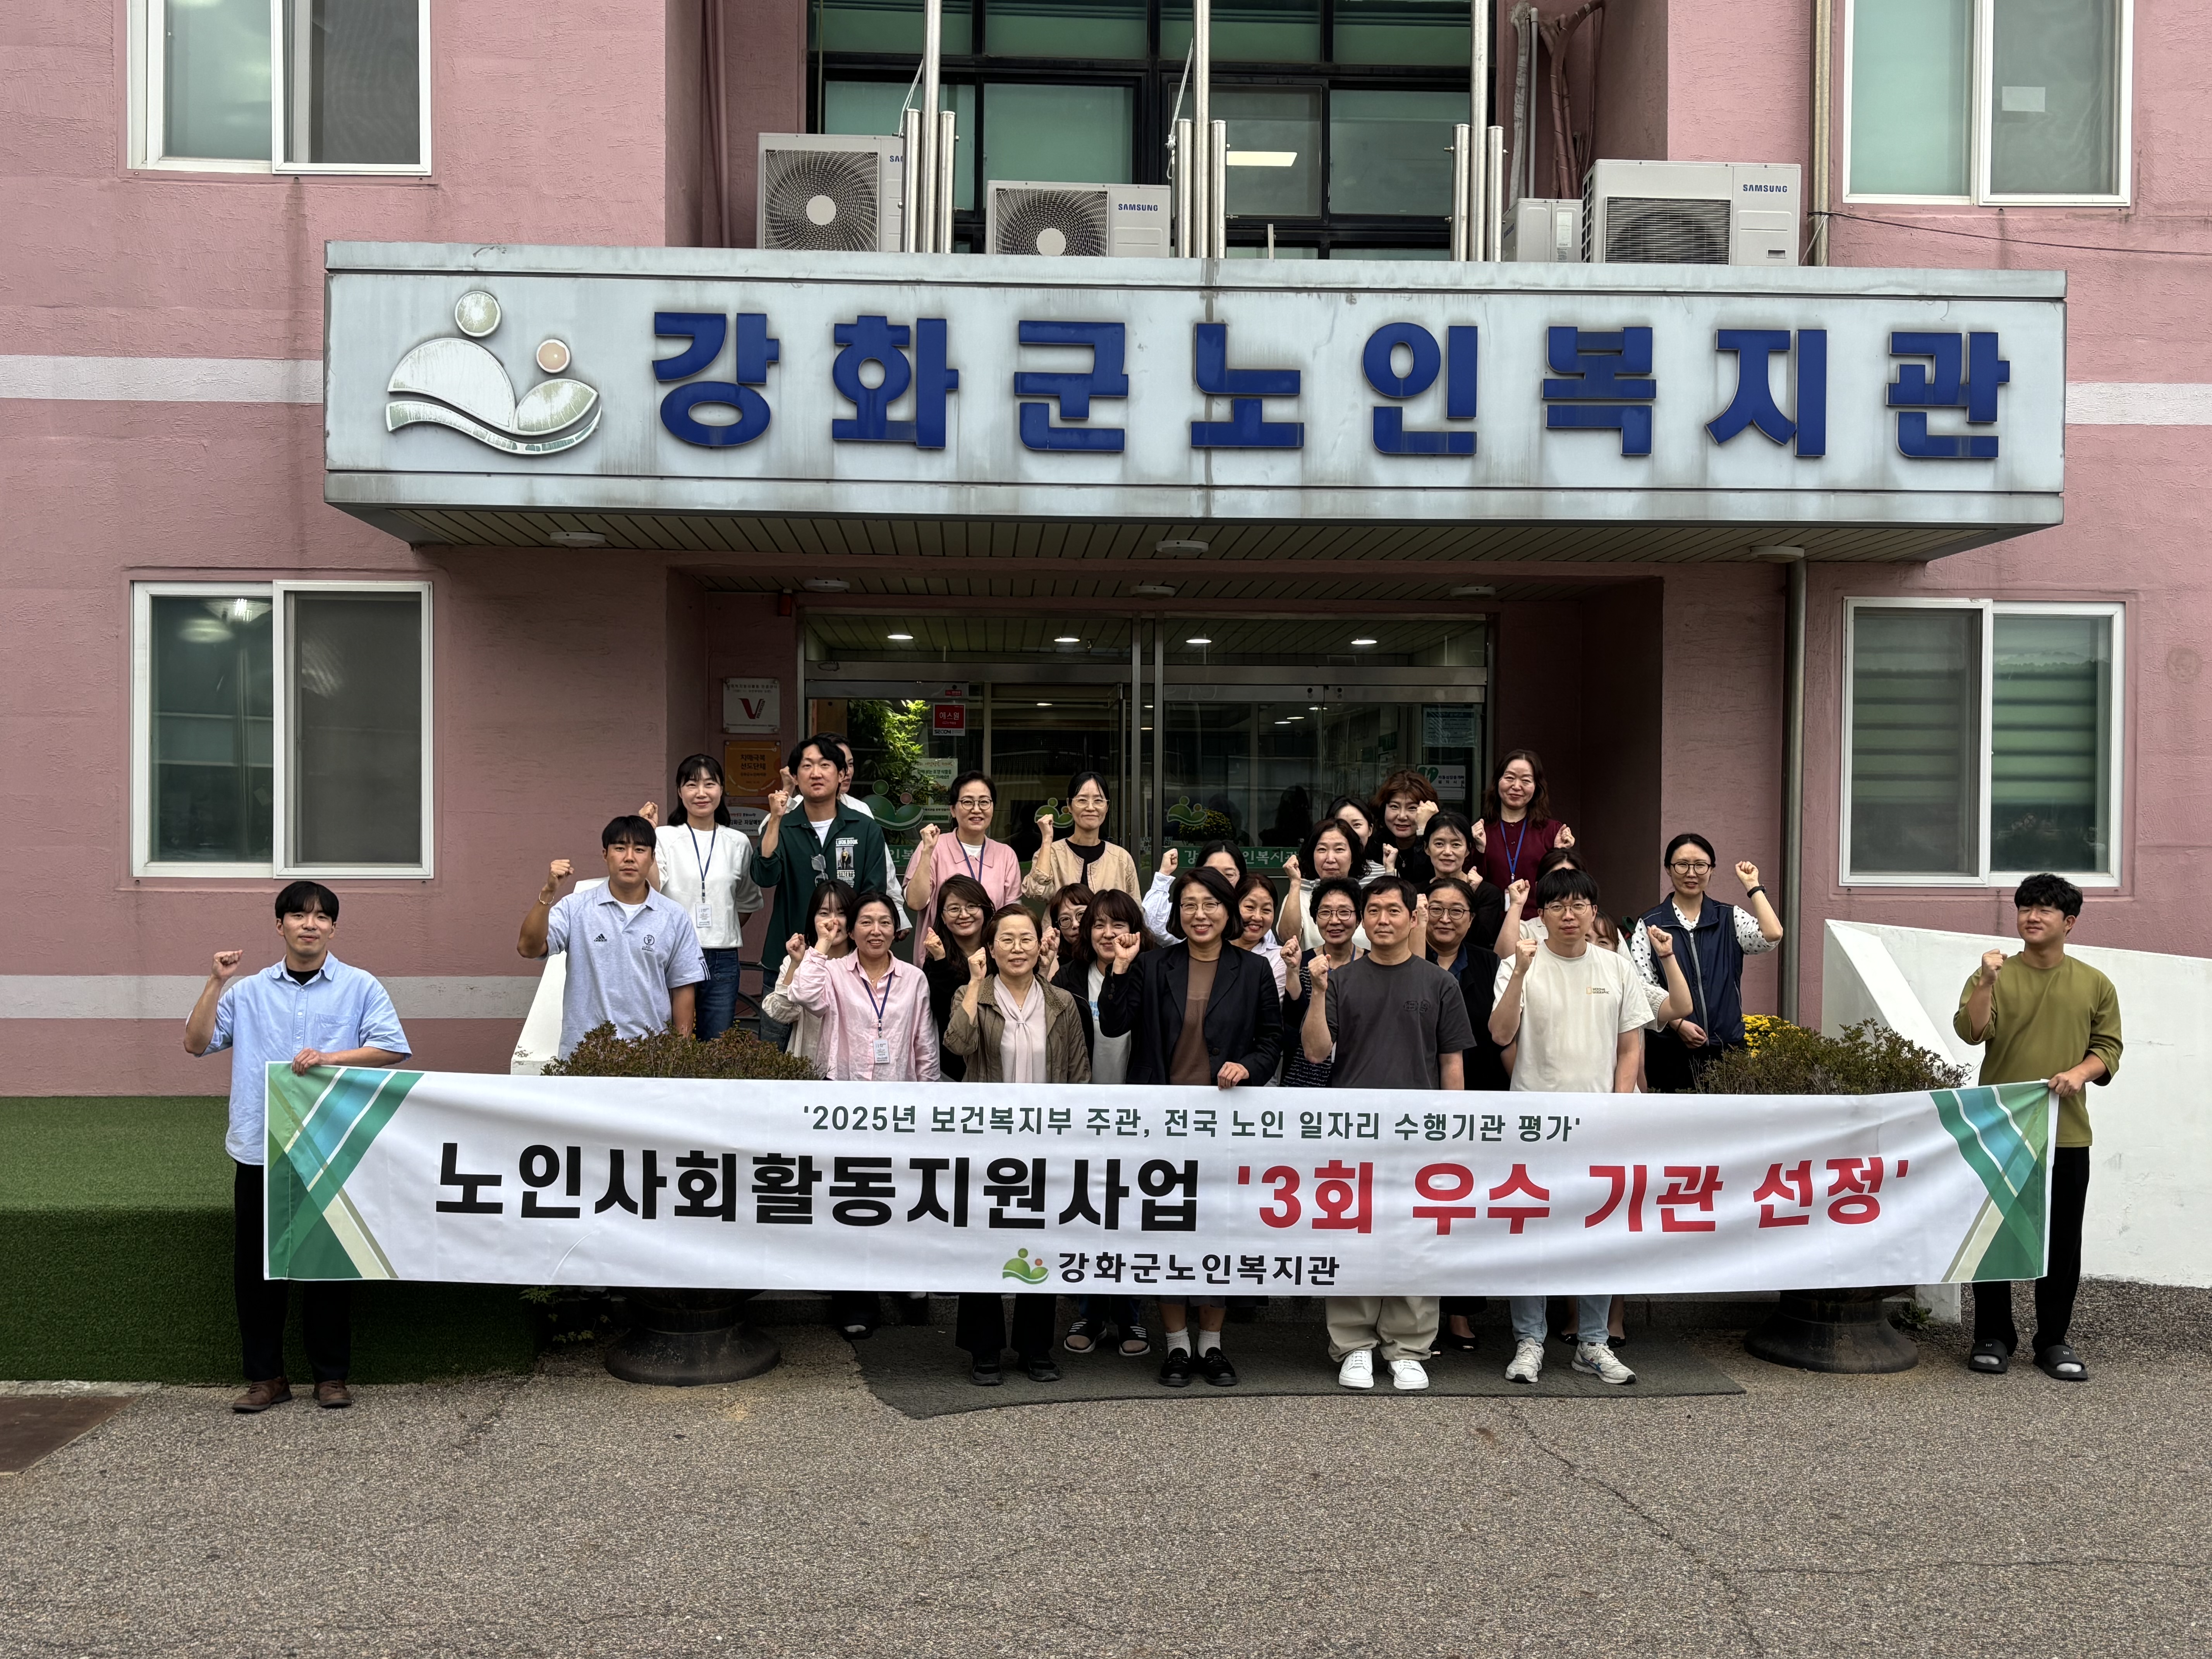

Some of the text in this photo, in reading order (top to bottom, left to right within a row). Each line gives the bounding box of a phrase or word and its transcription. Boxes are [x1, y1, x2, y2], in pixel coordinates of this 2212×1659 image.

[1743, 184, 1788, 192] SAMSUNG
[1118, 203, 1158, 211] SAMSUNG
[653, 312, 2011, 459] 강화군노인복지관
[939, 711, 960, 720] 에스원
[804, 1105, 1580, 1142] '2025년 보건복지부 주관, 전국 노인 일자리 수행기관 평가'
[436, 1142, 1910, 1236] 노인사회활동지원사업 '3회 우수 기관 선정'
[1058, 1251, 1340, 1286] 강화군노인복지관
